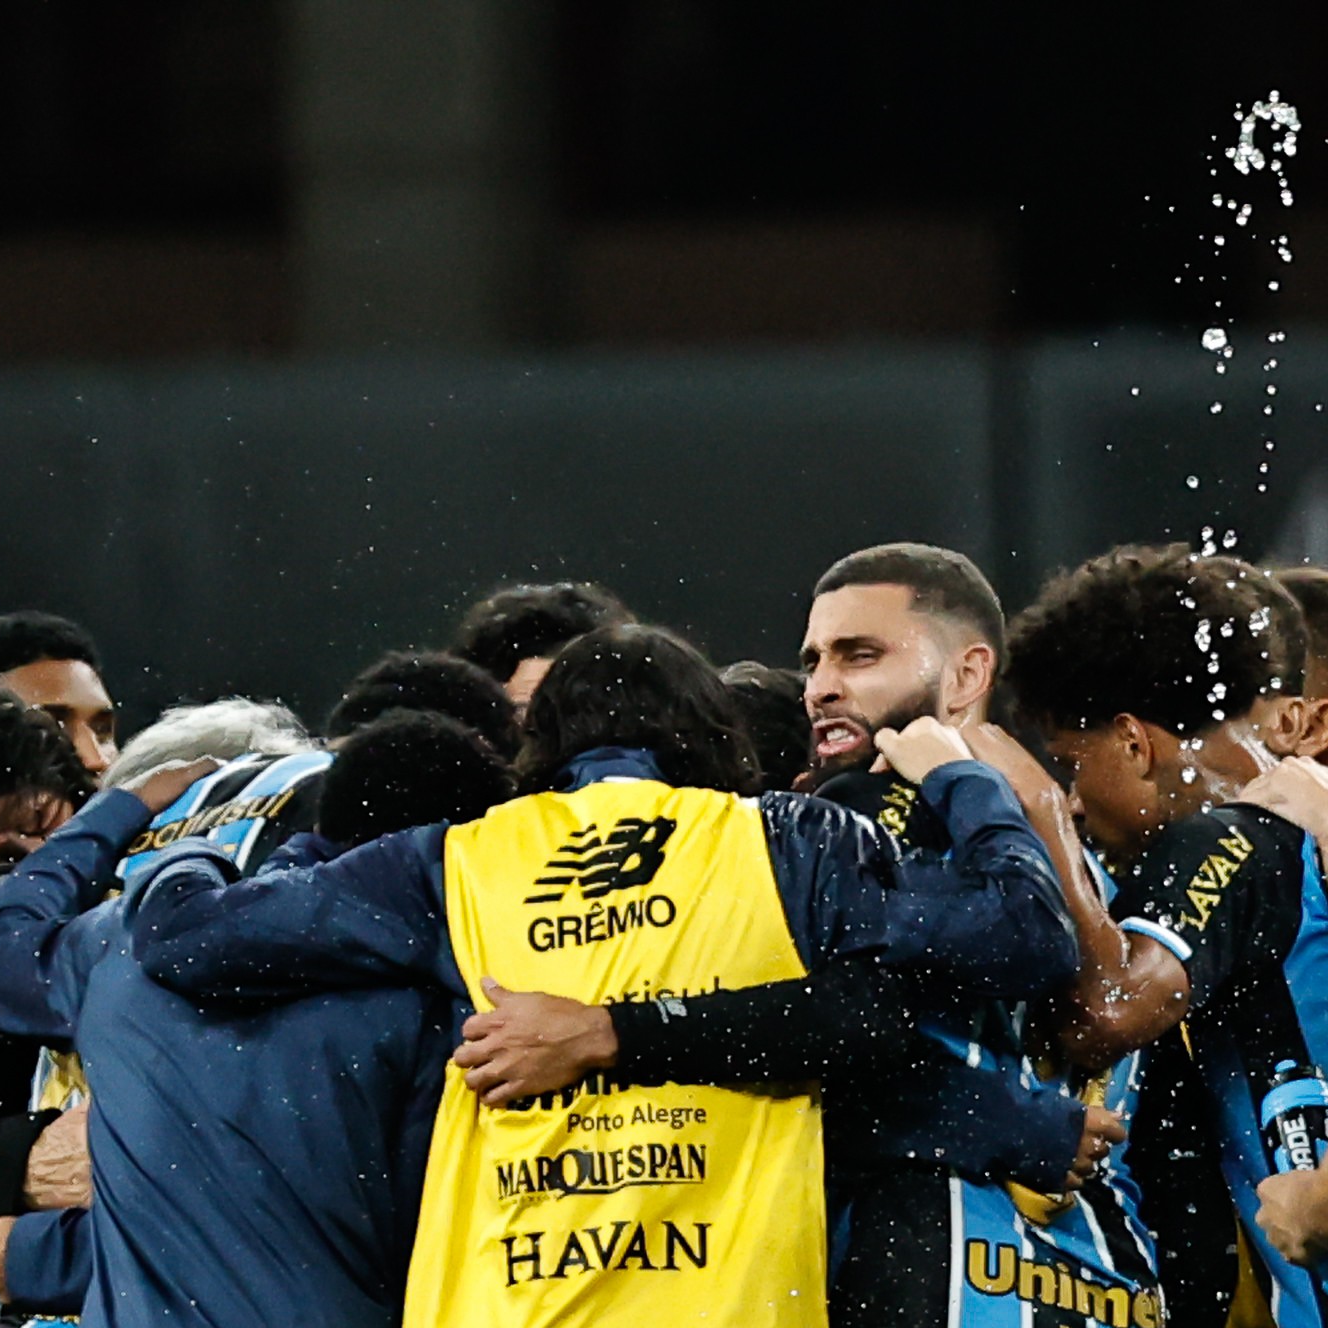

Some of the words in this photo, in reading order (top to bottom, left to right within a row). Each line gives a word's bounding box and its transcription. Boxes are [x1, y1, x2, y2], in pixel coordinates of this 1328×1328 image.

[528, 894, 678, 952] GRÊMIO
[567, 1112, 624, 1133] Porto
[630, 1103, 707, 1130] Alegre
[495, 1143, 707, 1200] MARQUESPAN
[500, 1220, 712, 1287] HAVAN
